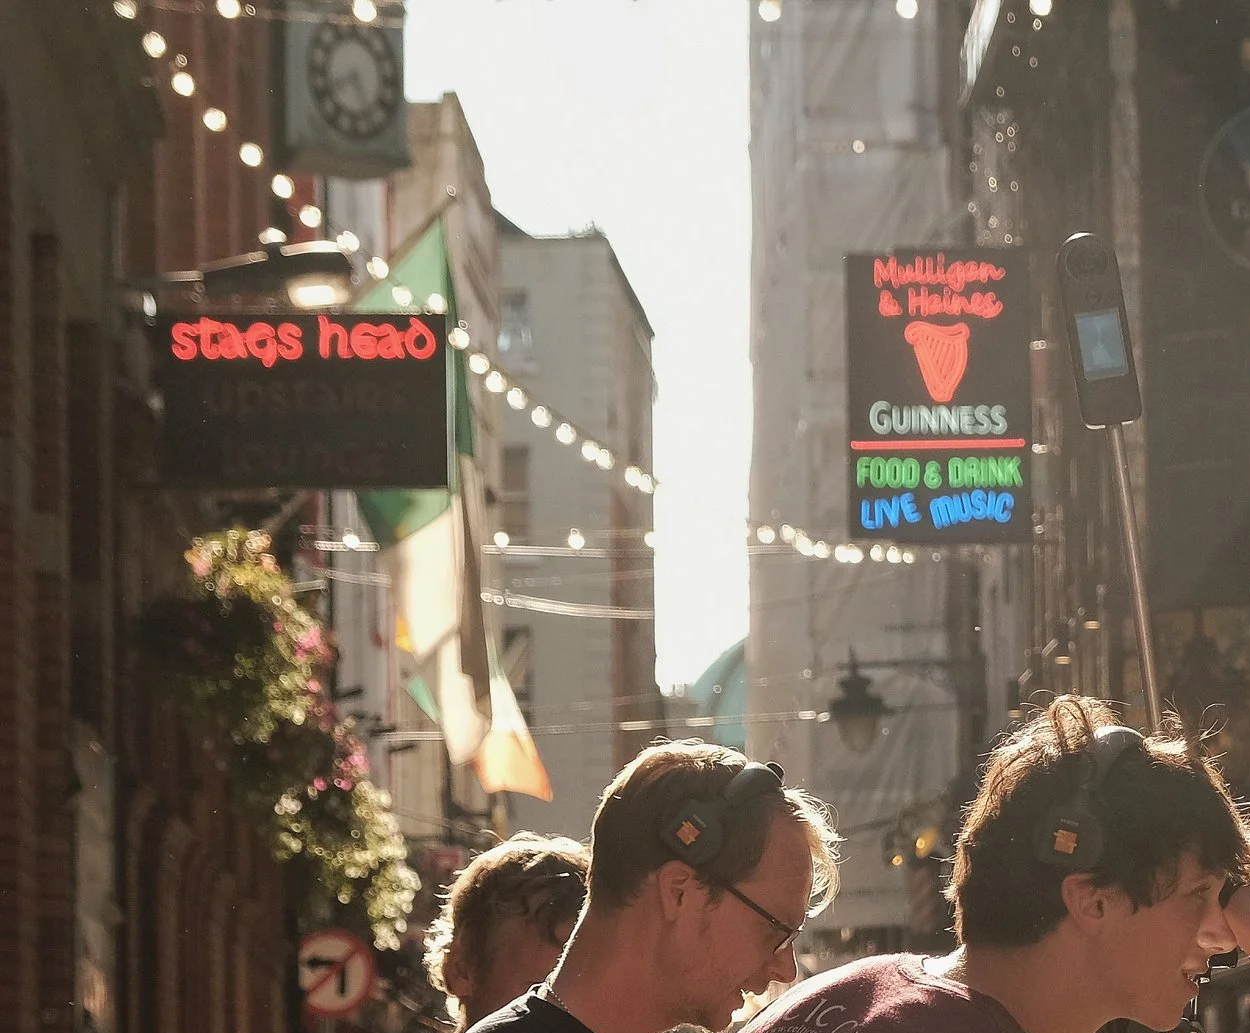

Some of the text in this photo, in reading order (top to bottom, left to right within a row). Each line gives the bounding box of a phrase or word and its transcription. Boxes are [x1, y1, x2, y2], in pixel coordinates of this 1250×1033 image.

[873, 253, 1007, 291] Mulligan
[878, 287, 1004, 319] & Haines
[171, 315, 438, 368] stags head
[868, 400, 1008, 435] GUINNESS
[856, 456, 1024, 490] FOOD & DRINK
[860, 489, 1015, 530] LIVE MUSIC
